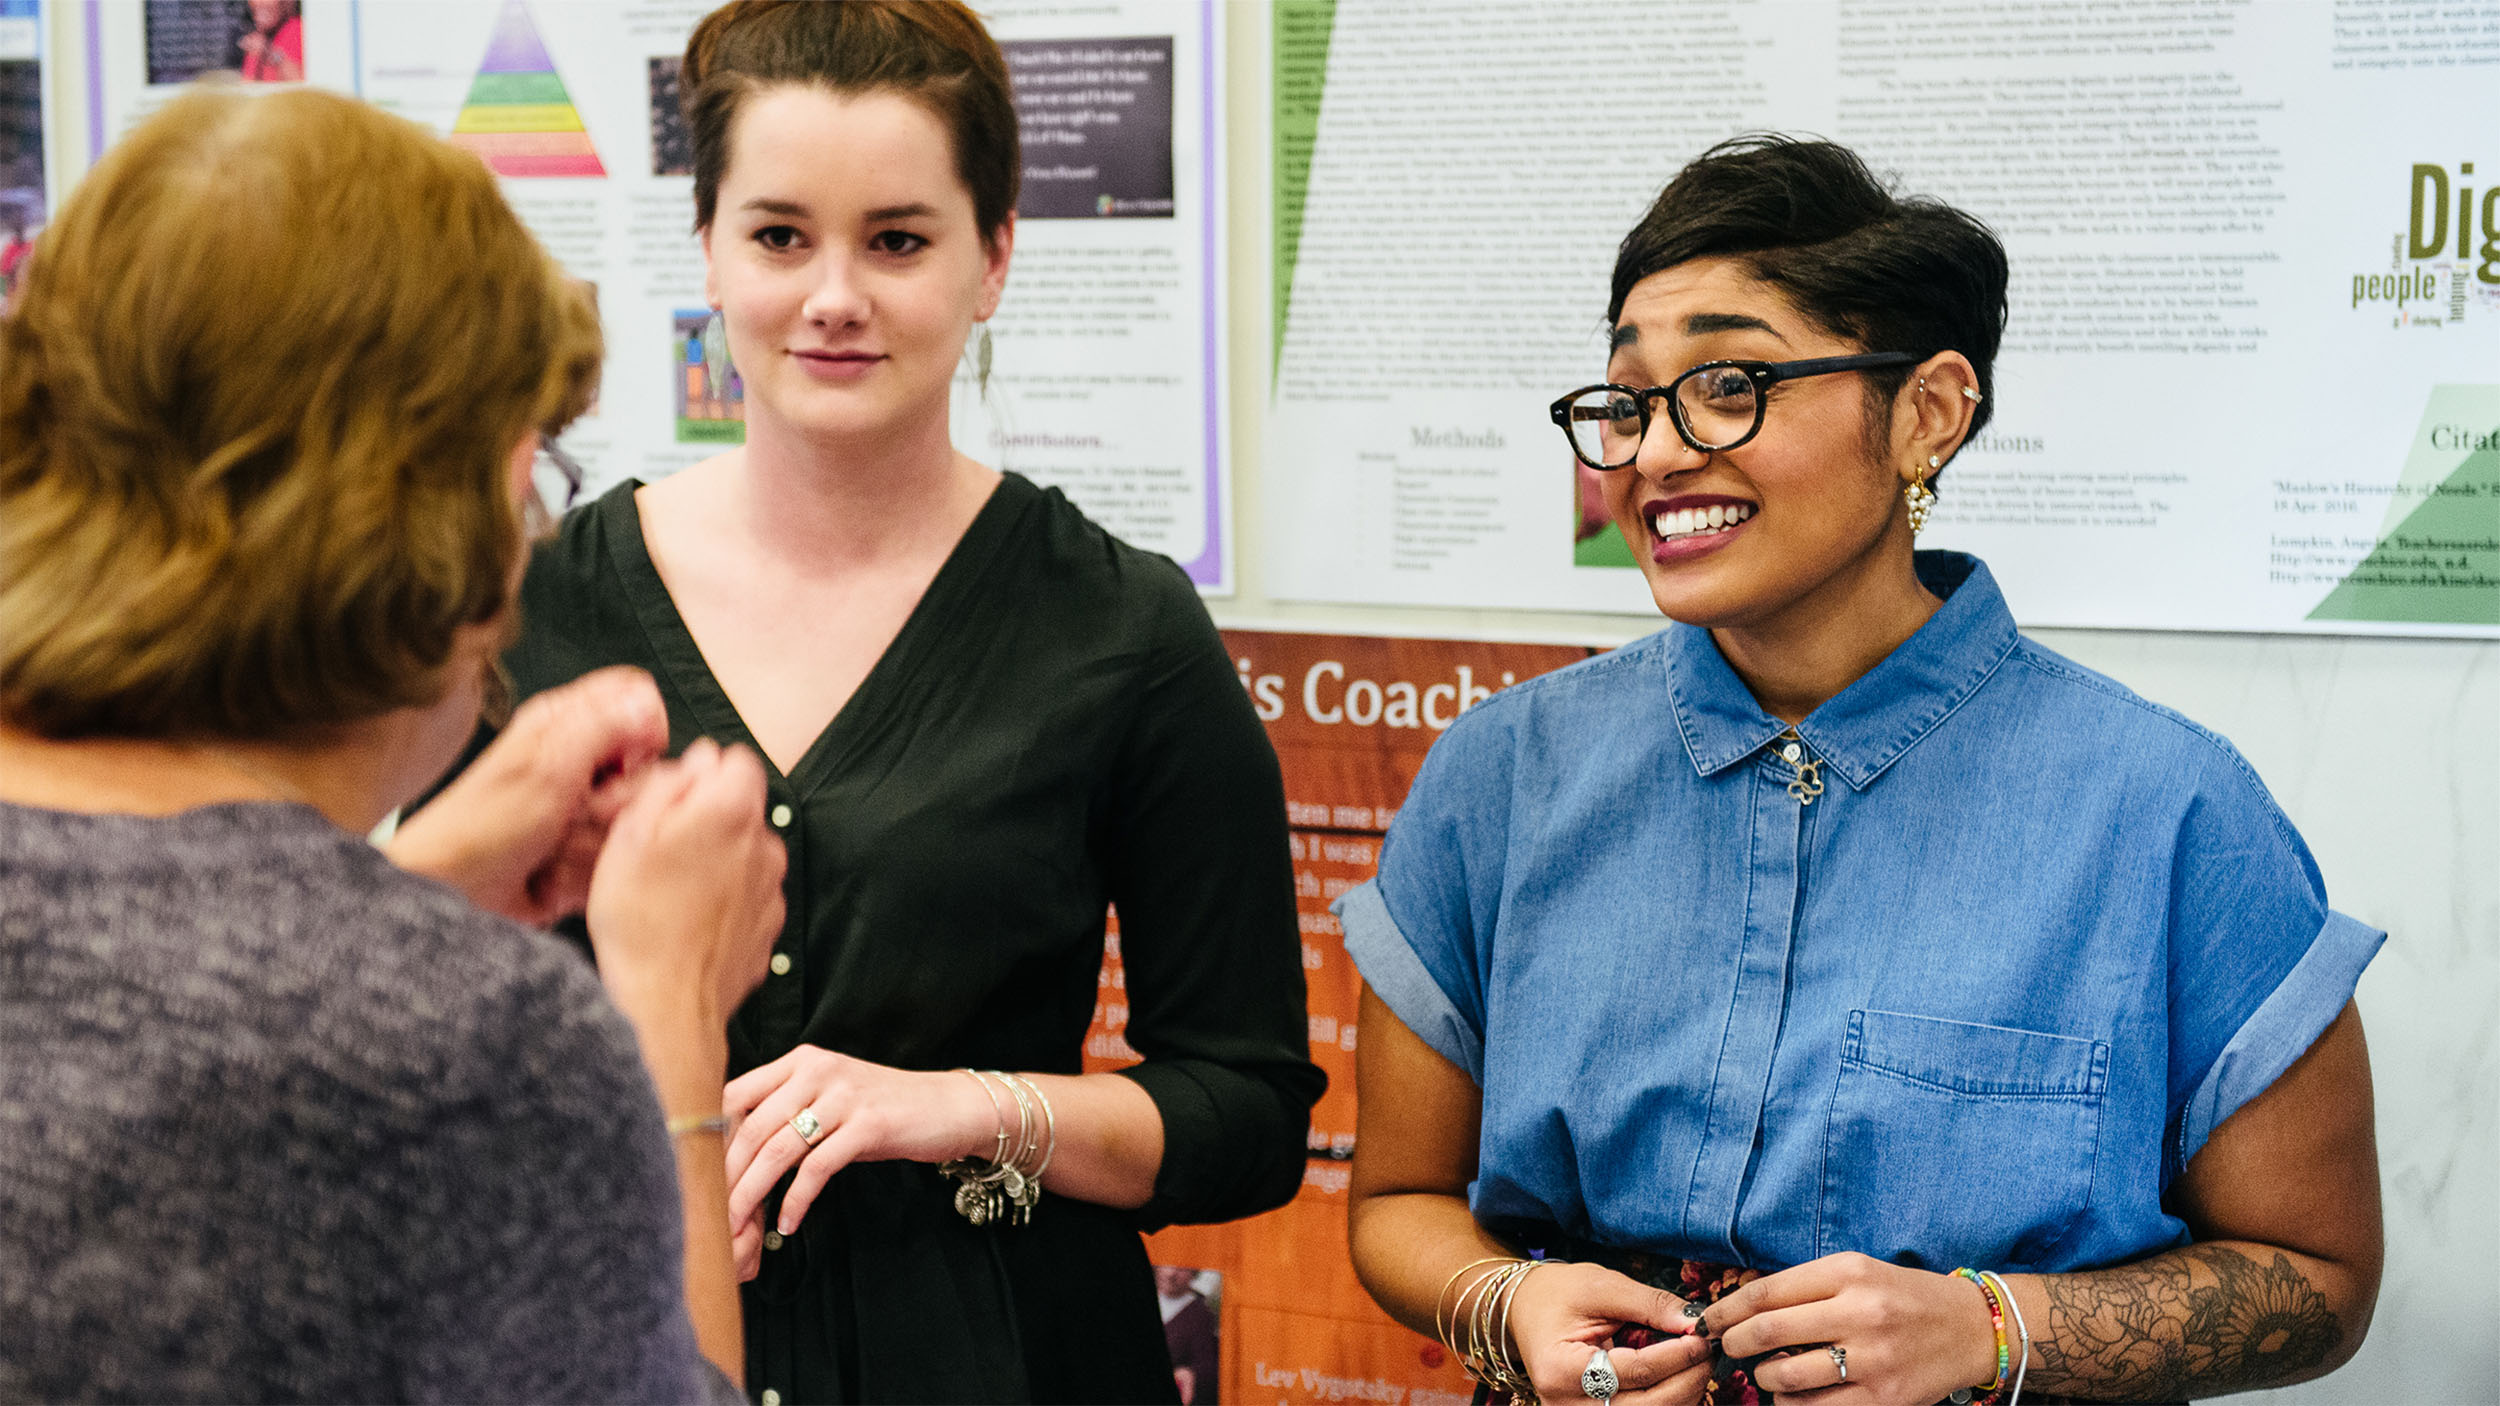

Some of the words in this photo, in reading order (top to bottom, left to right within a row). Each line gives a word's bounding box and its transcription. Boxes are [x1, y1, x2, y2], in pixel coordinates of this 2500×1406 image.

[2408, 162, 2500, 285] Dig
[2352, 266, 2436, 309] people
[1410, 427, 1506, 449] Methods
[1237, 658, 1285, 721] is
[1303, 661, 1516, 731] Coach
[1254, 1361, 1298, 1389] Lev
